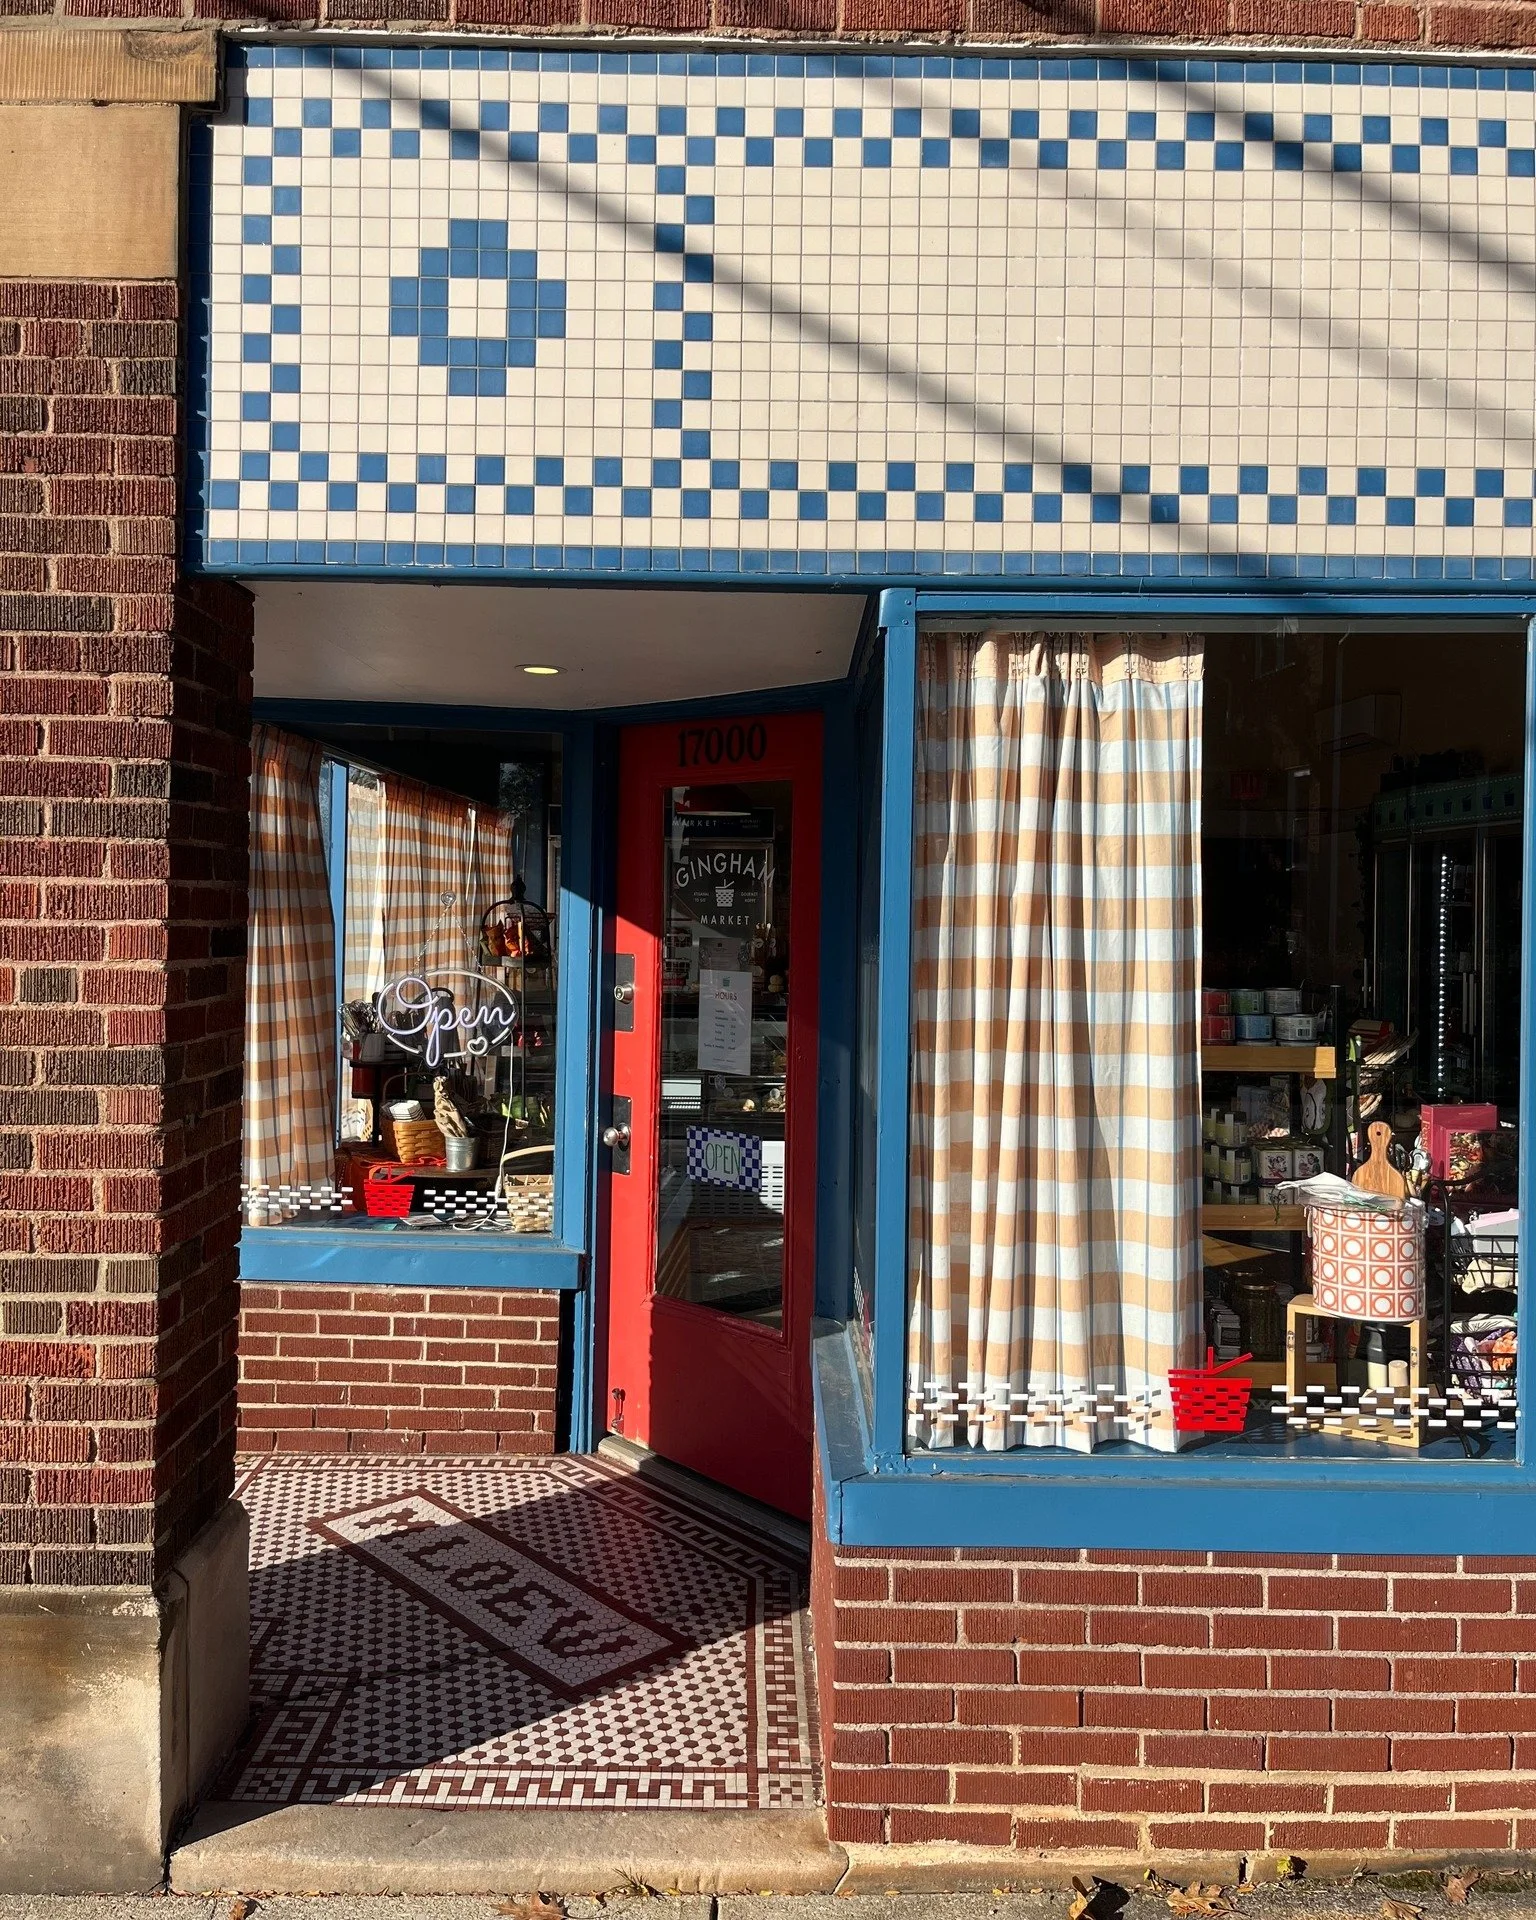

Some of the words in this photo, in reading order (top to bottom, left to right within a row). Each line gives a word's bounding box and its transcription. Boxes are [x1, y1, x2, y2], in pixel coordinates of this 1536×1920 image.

[678, 722, 768, 768] 17000
[676, 853, 775, 888] GINGHAM
[700, 915, 750, 925] MARKET
[714, 991, 738, 1001] HOURS
[378, 977, 516, 1067] Open
[704, 1142, 741, 1178] OPEN
